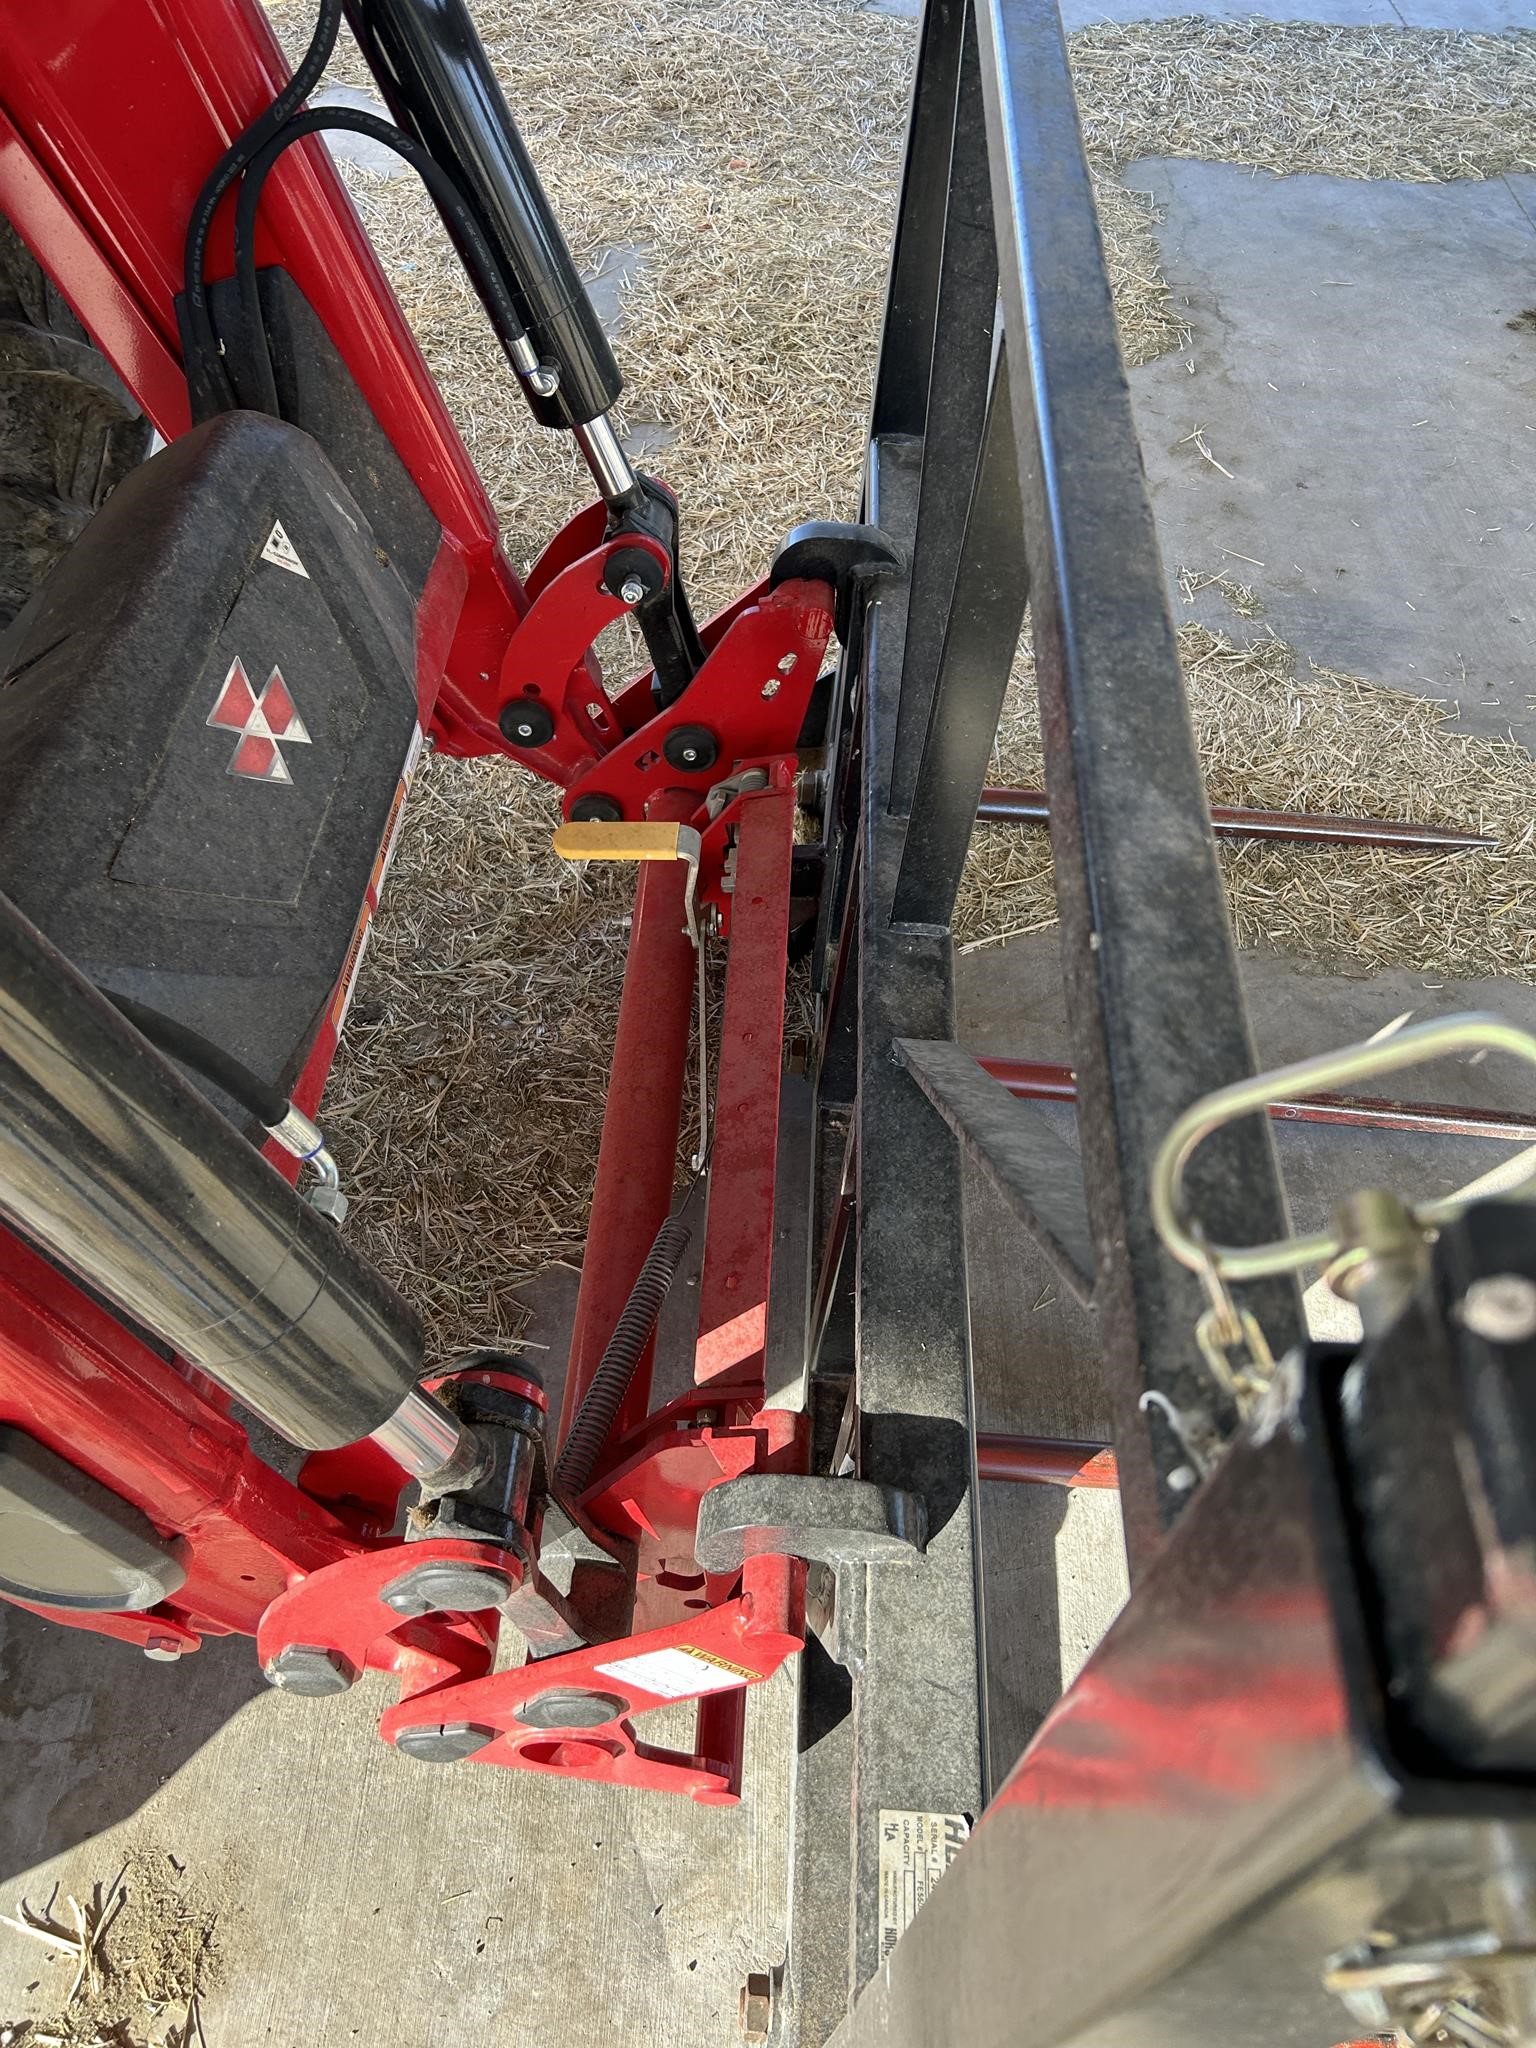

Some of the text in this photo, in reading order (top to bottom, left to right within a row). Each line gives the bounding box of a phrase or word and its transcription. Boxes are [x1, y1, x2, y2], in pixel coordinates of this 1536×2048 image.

[694, 1651, 758, 1680] WARNING
[916, 1815, 924, 1844] MODEL
[945, 1818, 966, 1867] HL
